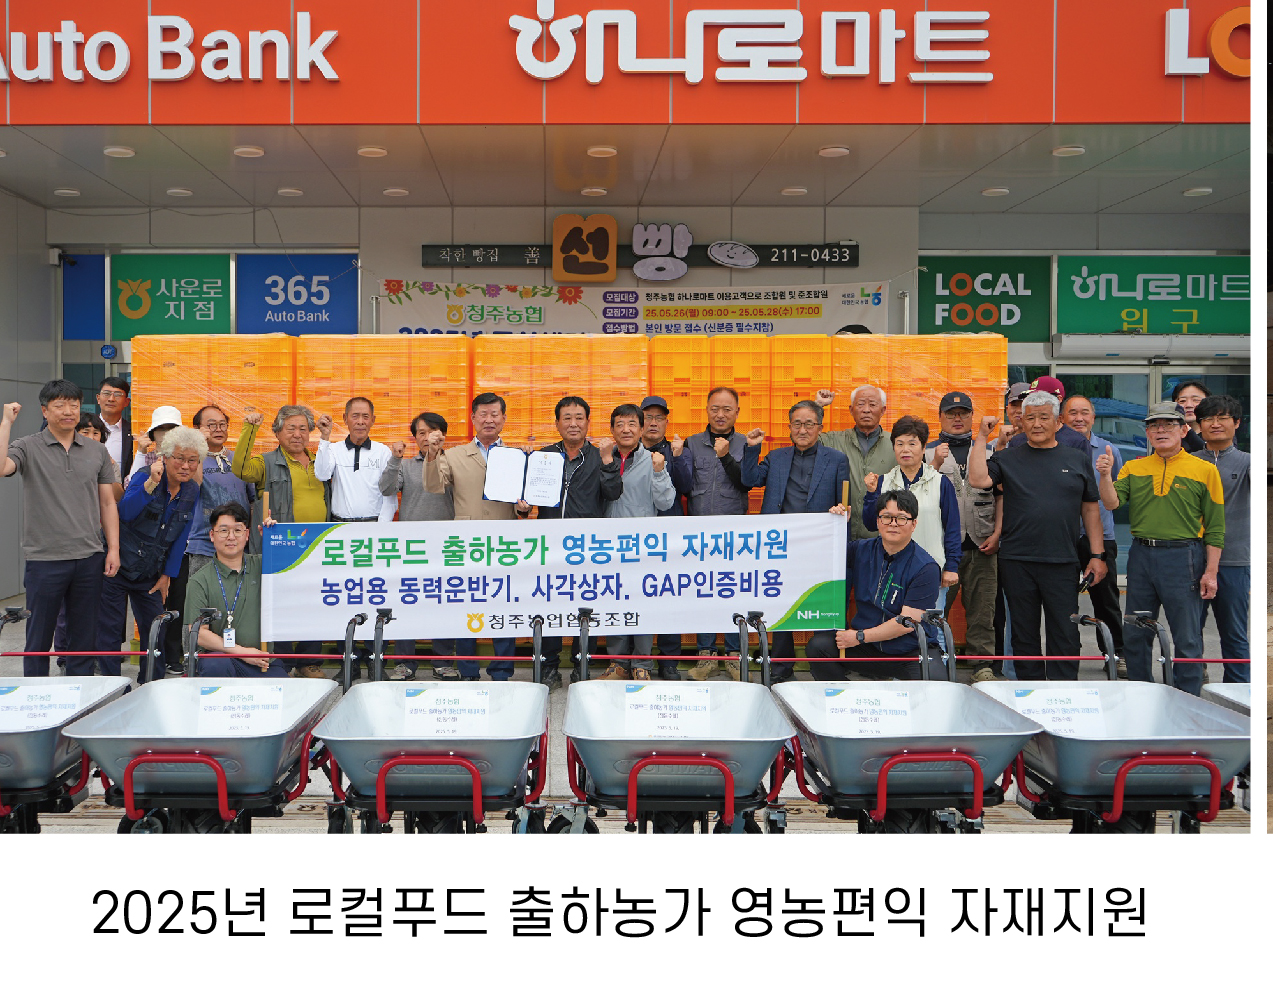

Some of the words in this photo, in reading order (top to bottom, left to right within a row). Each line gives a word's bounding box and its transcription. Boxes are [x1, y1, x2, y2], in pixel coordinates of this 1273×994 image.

[0, 20, 131, 83] uto
[147, 12, 341, 83] Bank
[508, 0, 994, 84] 하나로마트
[439, 248, 466, 263] 착한
[472, 248, 499, 263] 빵집
[524, 247, 541, 264] 善
[560, 226, 610, 275] 선
[632, 222, 694, 282] 빵
[770, 248, 850, 262] 211-0433
[156, 278, 224, 300] 사운로
[264, 275, 331, 307] 365
[935, 272, 1032, 297] LOCAL
[1070, 265, 1250, 301] 하나로마트
[605, 293, 637, 303] 모집대상
[645, 291, 675, 302] 청주농협
[677, 291, 715, 302] 하나로마트
[764, 290, 787, 301] 조합원
[788, 290, 796, 300] 및
[265, 309, 297, 323] Auto
[297, 308, 331, 323] Bank
[466, 304, 543, 324] 청주농협
[605, 308, 637, 319] 모집기간
[645, 307, 700, 319] 25.05.26(월)
[701, 308, 729, 318] 09:00
[739, 307, 793, 318] 25.05.28(수)
[796, 306, 820, 316] 17:00
[935, 302, 1021, 327] FOOD
[645, 322, 662, 334] 본인
[664, 322, 682, 334] 방문
[684, 322, 702, 334] 접수
[703, 322, 734, 334] (신분증
[321, 536, 429, 568] 로컬푸드
[441, 535, 549, 566] 출하농가
[562, 532, 668, 565] 영농편익
[681, 529, 788, 561] 자재지원
[320, 577, 388, 606] 농업용
[642, 569, 783, 599] GAP인증비용
[797, 610, 820, 620] NH
